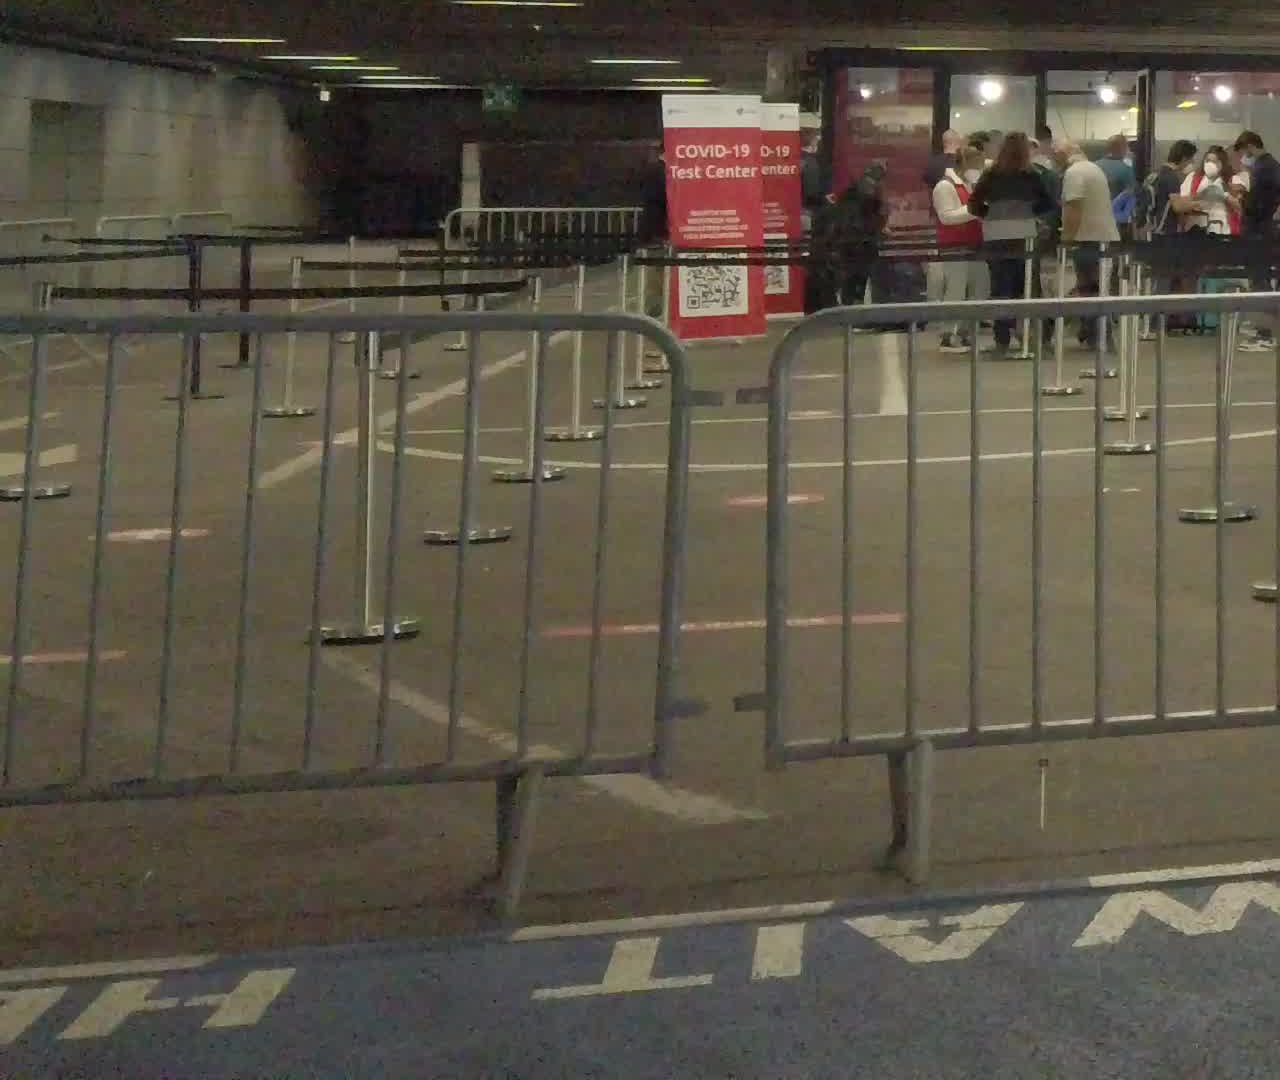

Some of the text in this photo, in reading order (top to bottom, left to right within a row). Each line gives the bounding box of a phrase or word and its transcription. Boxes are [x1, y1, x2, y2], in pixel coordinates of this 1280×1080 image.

[674, 143, 751, 159] COVID-19
[760, 145, 791, 158] D-19
[670, 164, 759, 179] Test Center
[761, 164, 797, 176] enter
